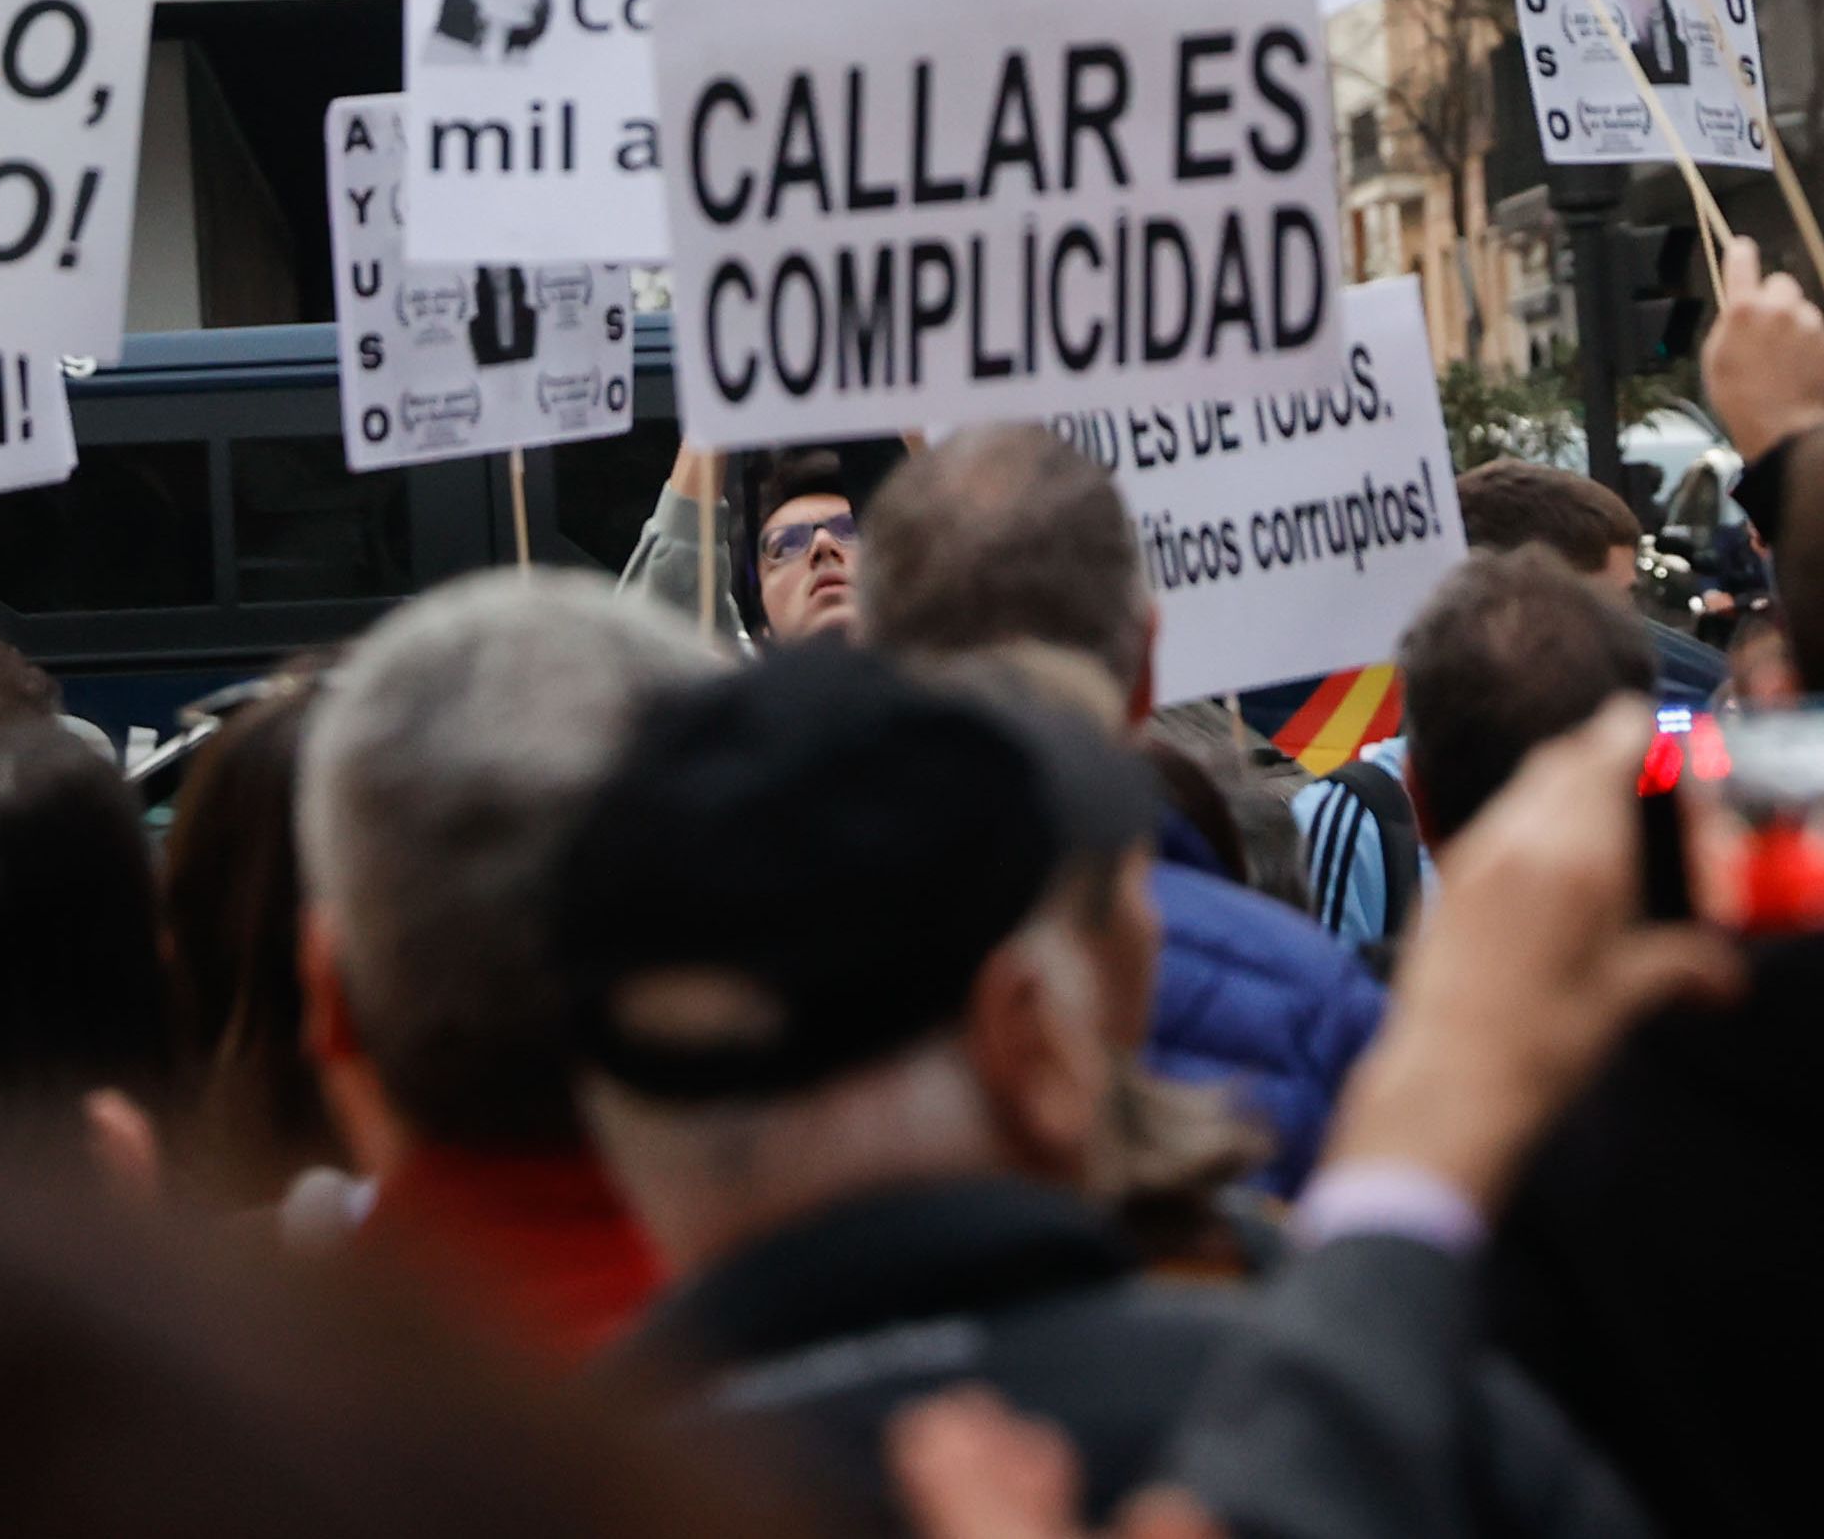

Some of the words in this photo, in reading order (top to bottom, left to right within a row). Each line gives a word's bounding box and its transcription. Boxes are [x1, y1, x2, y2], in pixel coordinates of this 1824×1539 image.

[430, 99, 576, 172] mil
[689, 40, 1132, 227] CALLAR
[1176, 24, 1314, 183] ES
[705, 202, 1326, 404] COMPLICIDAD
[1250, 457, 1442, 572] corruptos!
